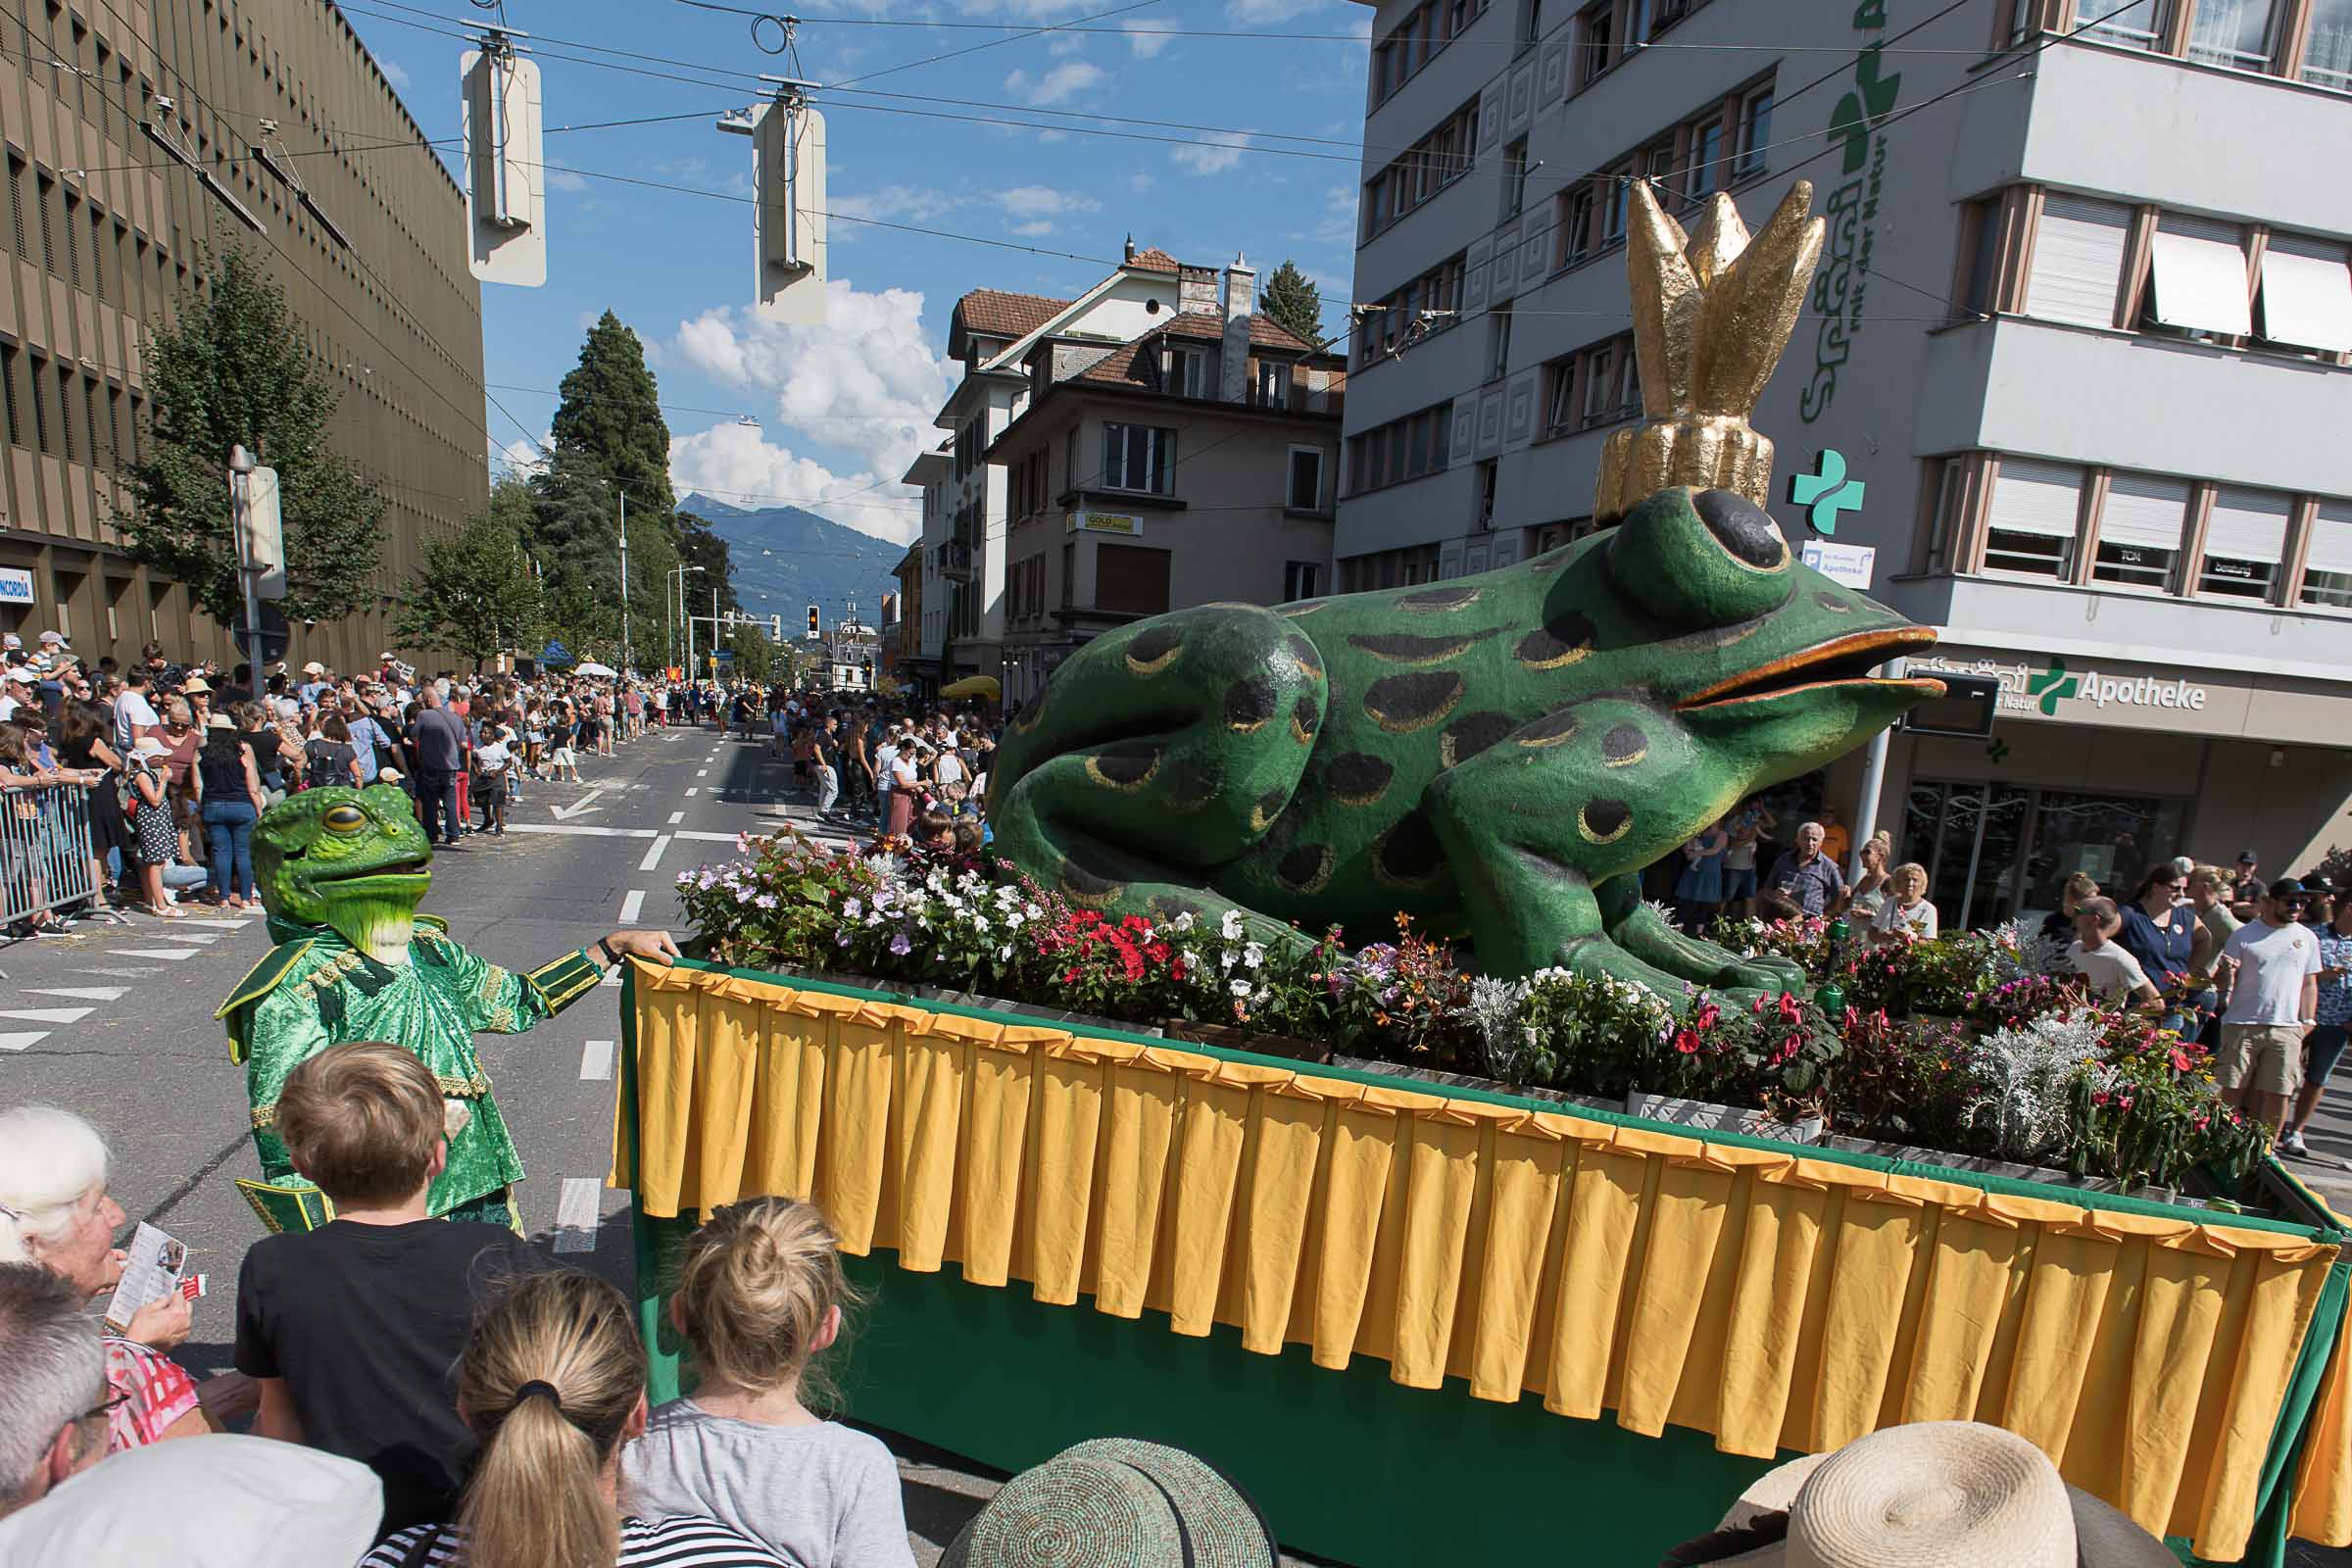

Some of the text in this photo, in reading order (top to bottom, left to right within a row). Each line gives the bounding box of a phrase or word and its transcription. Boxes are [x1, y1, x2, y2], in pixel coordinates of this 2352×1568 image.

[1862, 134, 1887, 220] Natur
[1856, 226, 1875, 275] der
[1089, 515, 1112, 525] GOLD
[1823, 564, 1864, 574] Apotheke
[2004, 695, 2037, 711] Natur
[2078, 671, 2205, 710] Apotheke
